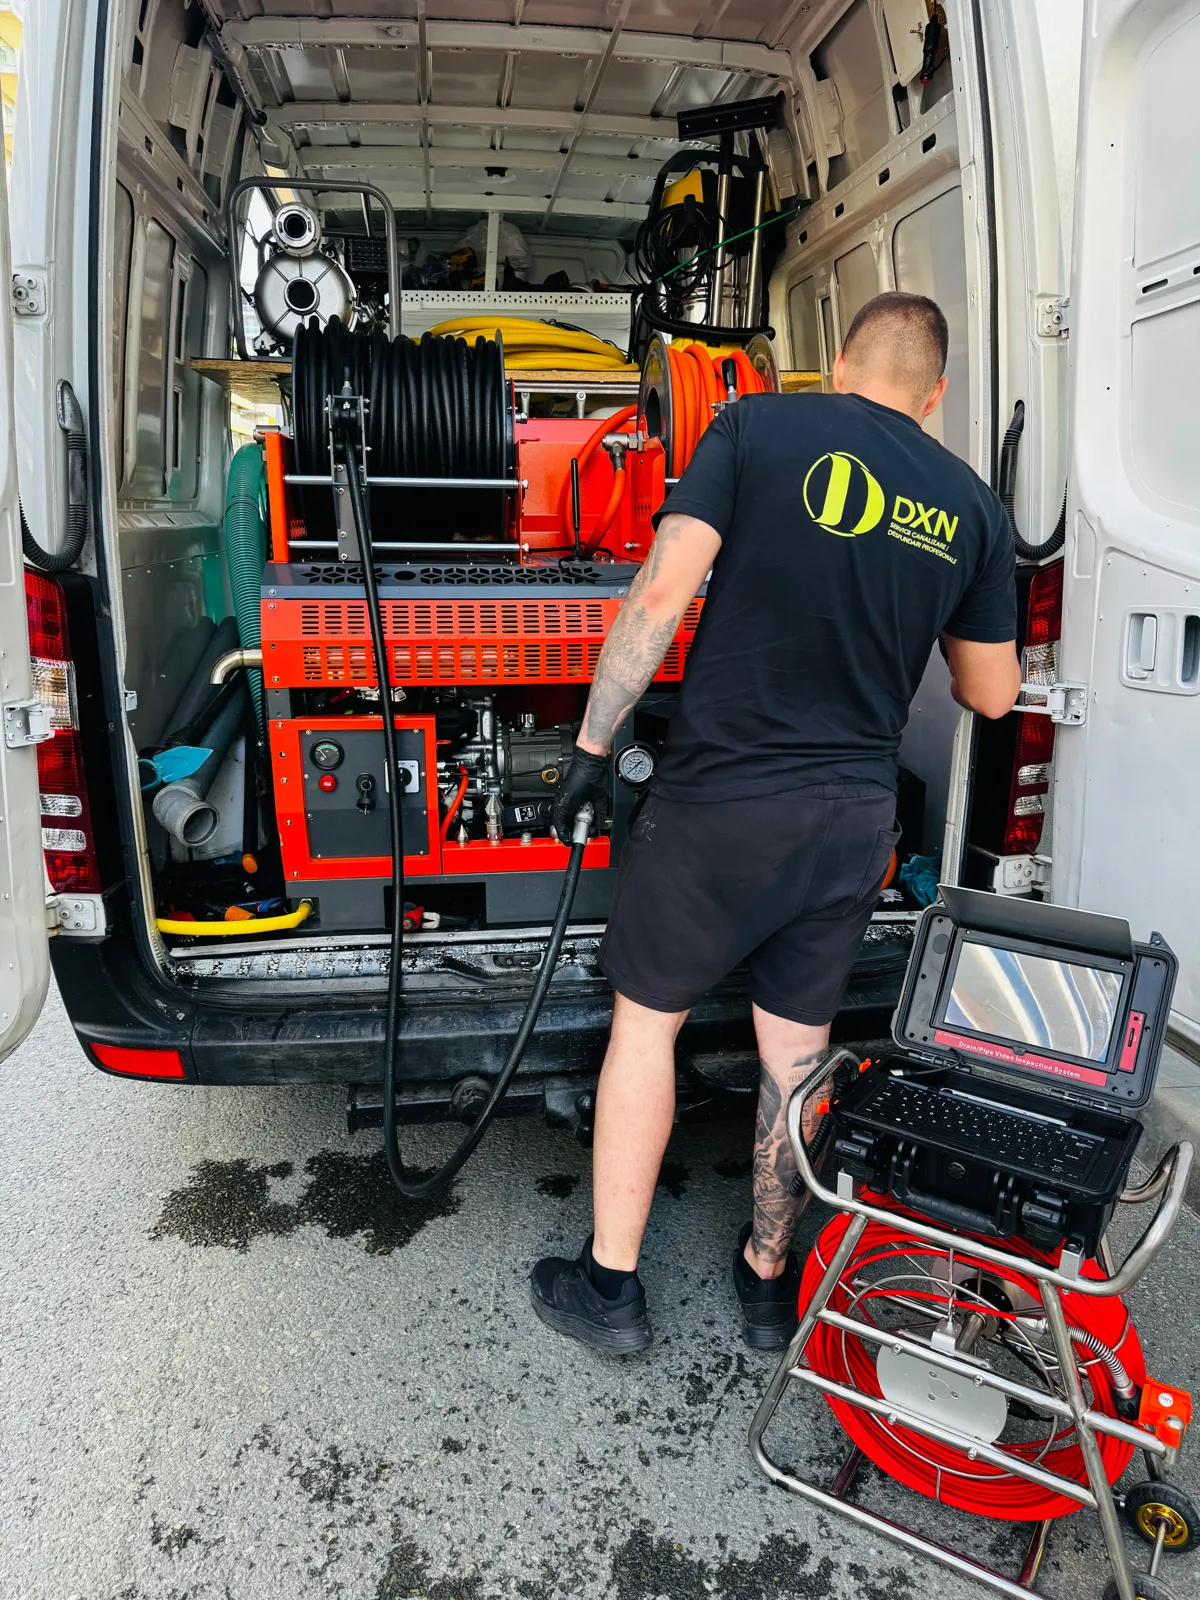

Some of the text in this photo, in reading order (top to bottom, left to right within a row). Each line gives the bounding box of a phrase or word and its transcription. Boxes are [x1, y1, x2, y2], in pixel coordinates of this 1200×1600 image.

[892, 495, 959, 543] DXN
[911, 532, 947, 551] CANALIZARE
[921, 543, 958, 565] PROFESIONALE
[958, 1041, 1081, 1079] Drain/Pipe Video Inspection System
